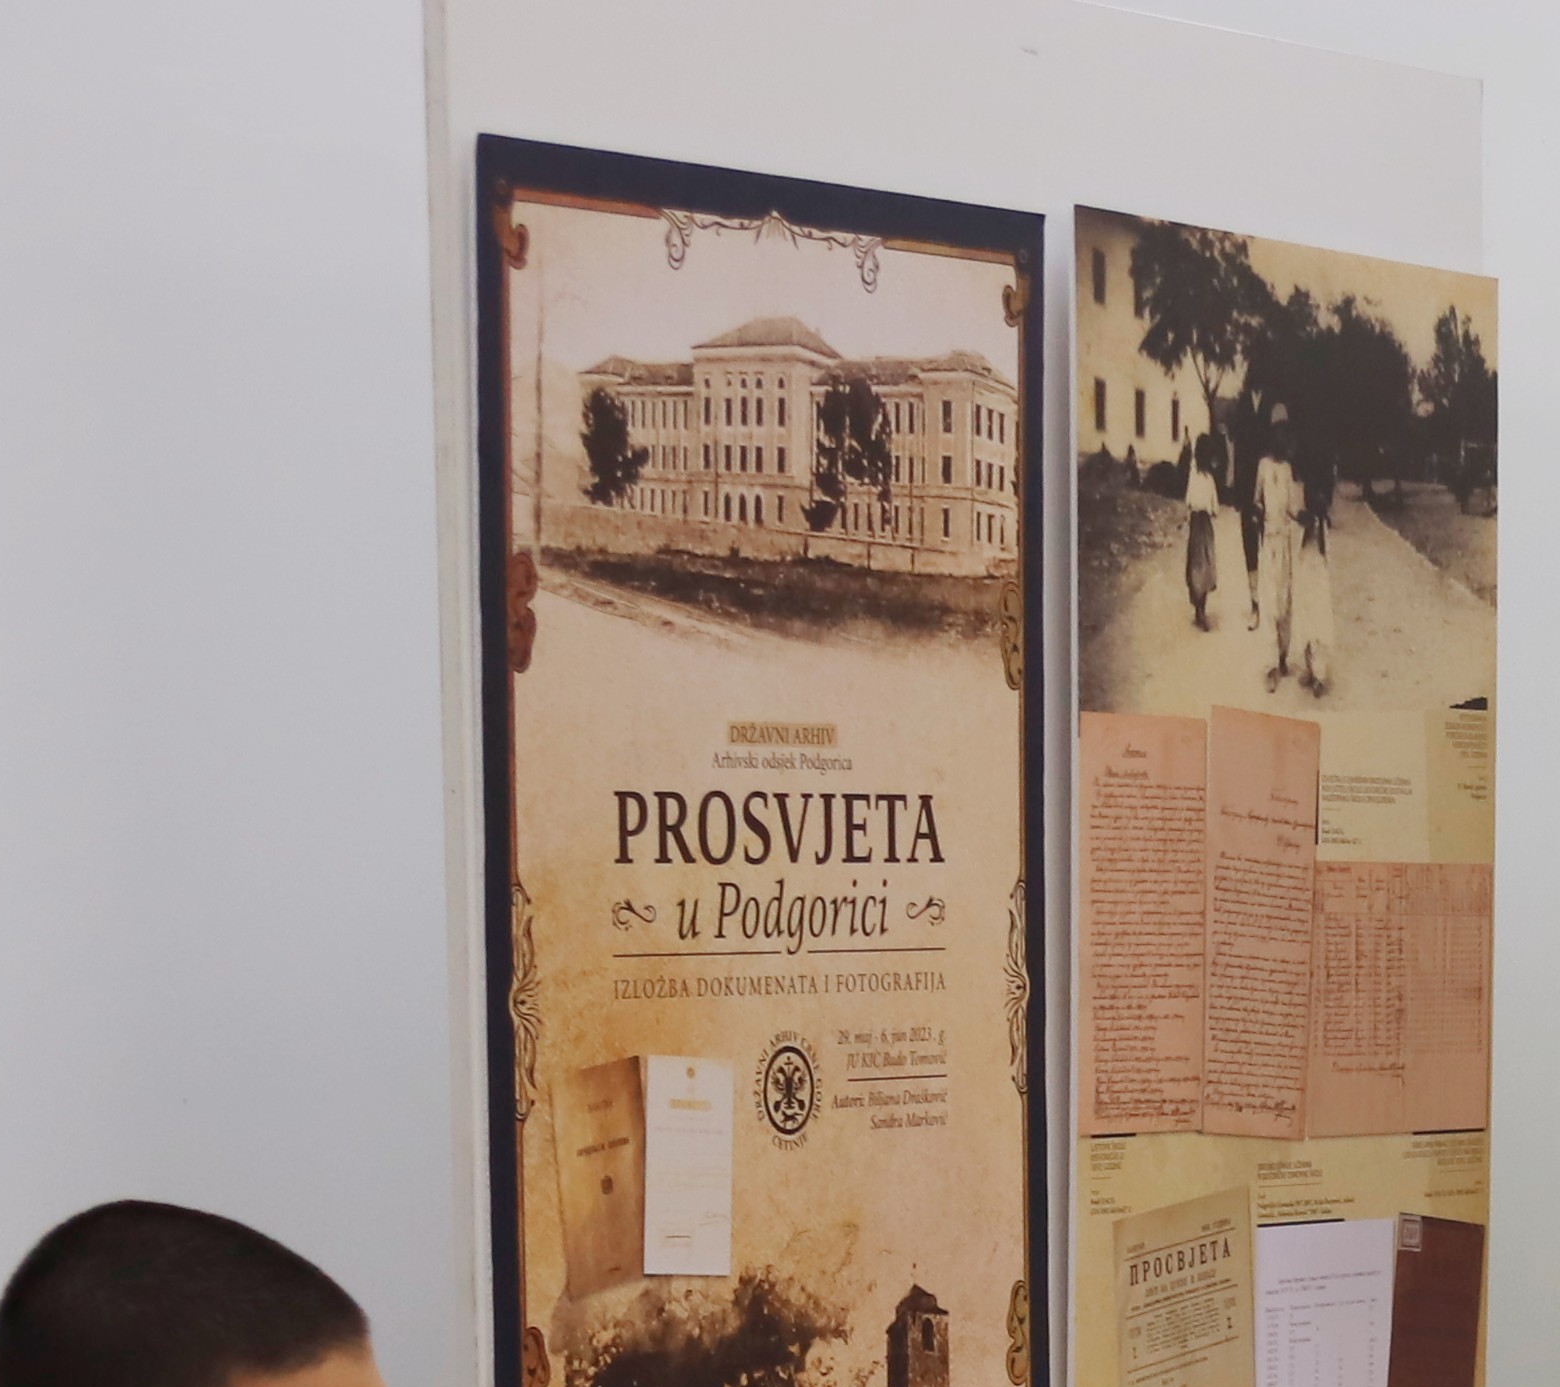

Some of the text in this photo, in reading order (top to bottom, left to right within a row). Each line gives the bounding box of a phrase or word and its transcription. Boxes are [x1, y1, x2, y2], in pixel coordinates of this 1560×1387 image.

[729, 723, 836, 746] DRŽAVNI ARHIV
[711, 752, 853, 776] Arhivski odsjek Podgorica
[613, 789, 946, 866] PROSVJETA
[677, 878, 890, 956] u Podgorici
[613, 971, 947, 1000] IZLOŽBA DOKUMENATA I FOTOGRAFIJA
[870, 1114, 904, 1131] Sandra
[1128, 1237, 1232, 1287] ПРОСВЈЕТА
